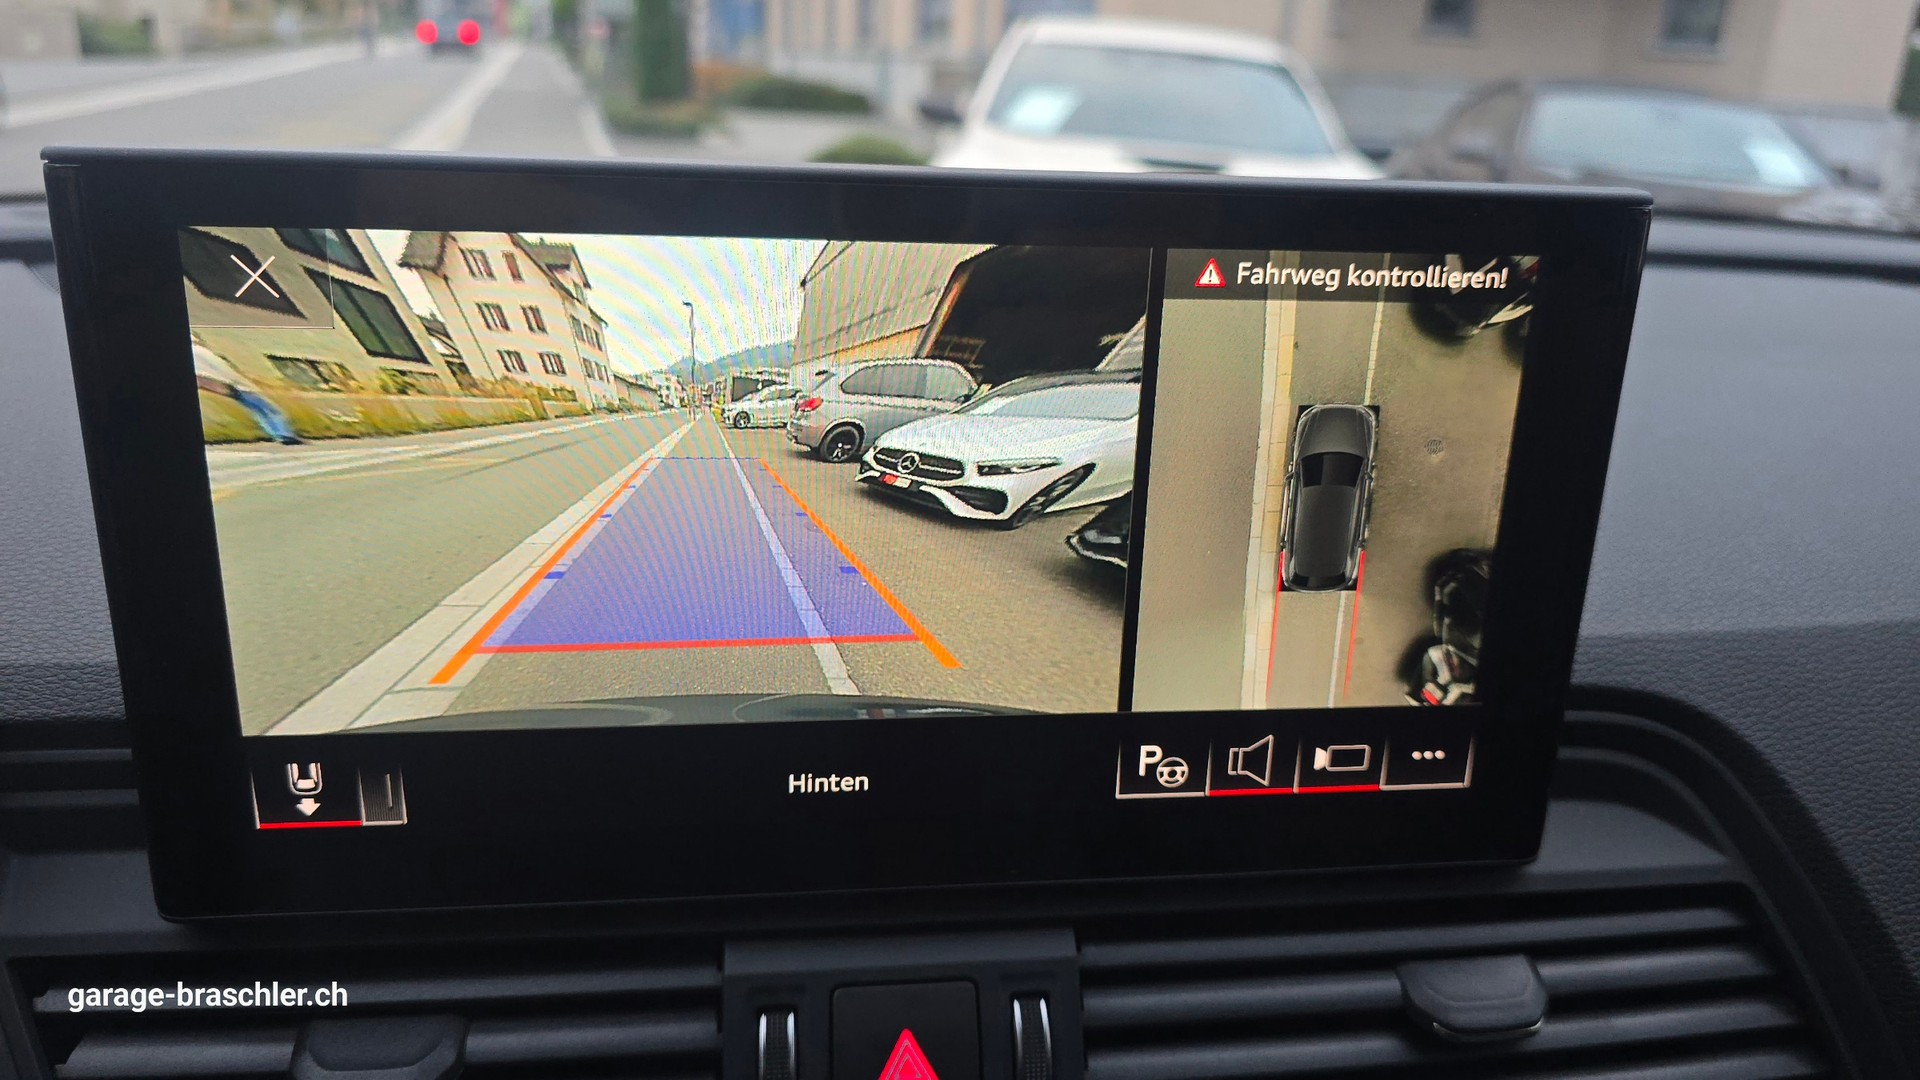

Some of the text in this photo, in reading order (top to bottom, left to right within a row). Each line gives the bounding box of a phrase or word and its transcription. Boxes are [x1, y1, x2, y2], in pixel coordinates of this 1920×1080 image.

[1236, 262, 1508, 291] Fahrweg kontrollieren!
[1138, 745, 1163, 777] P
[788, 773, 869, 794] Hinten
